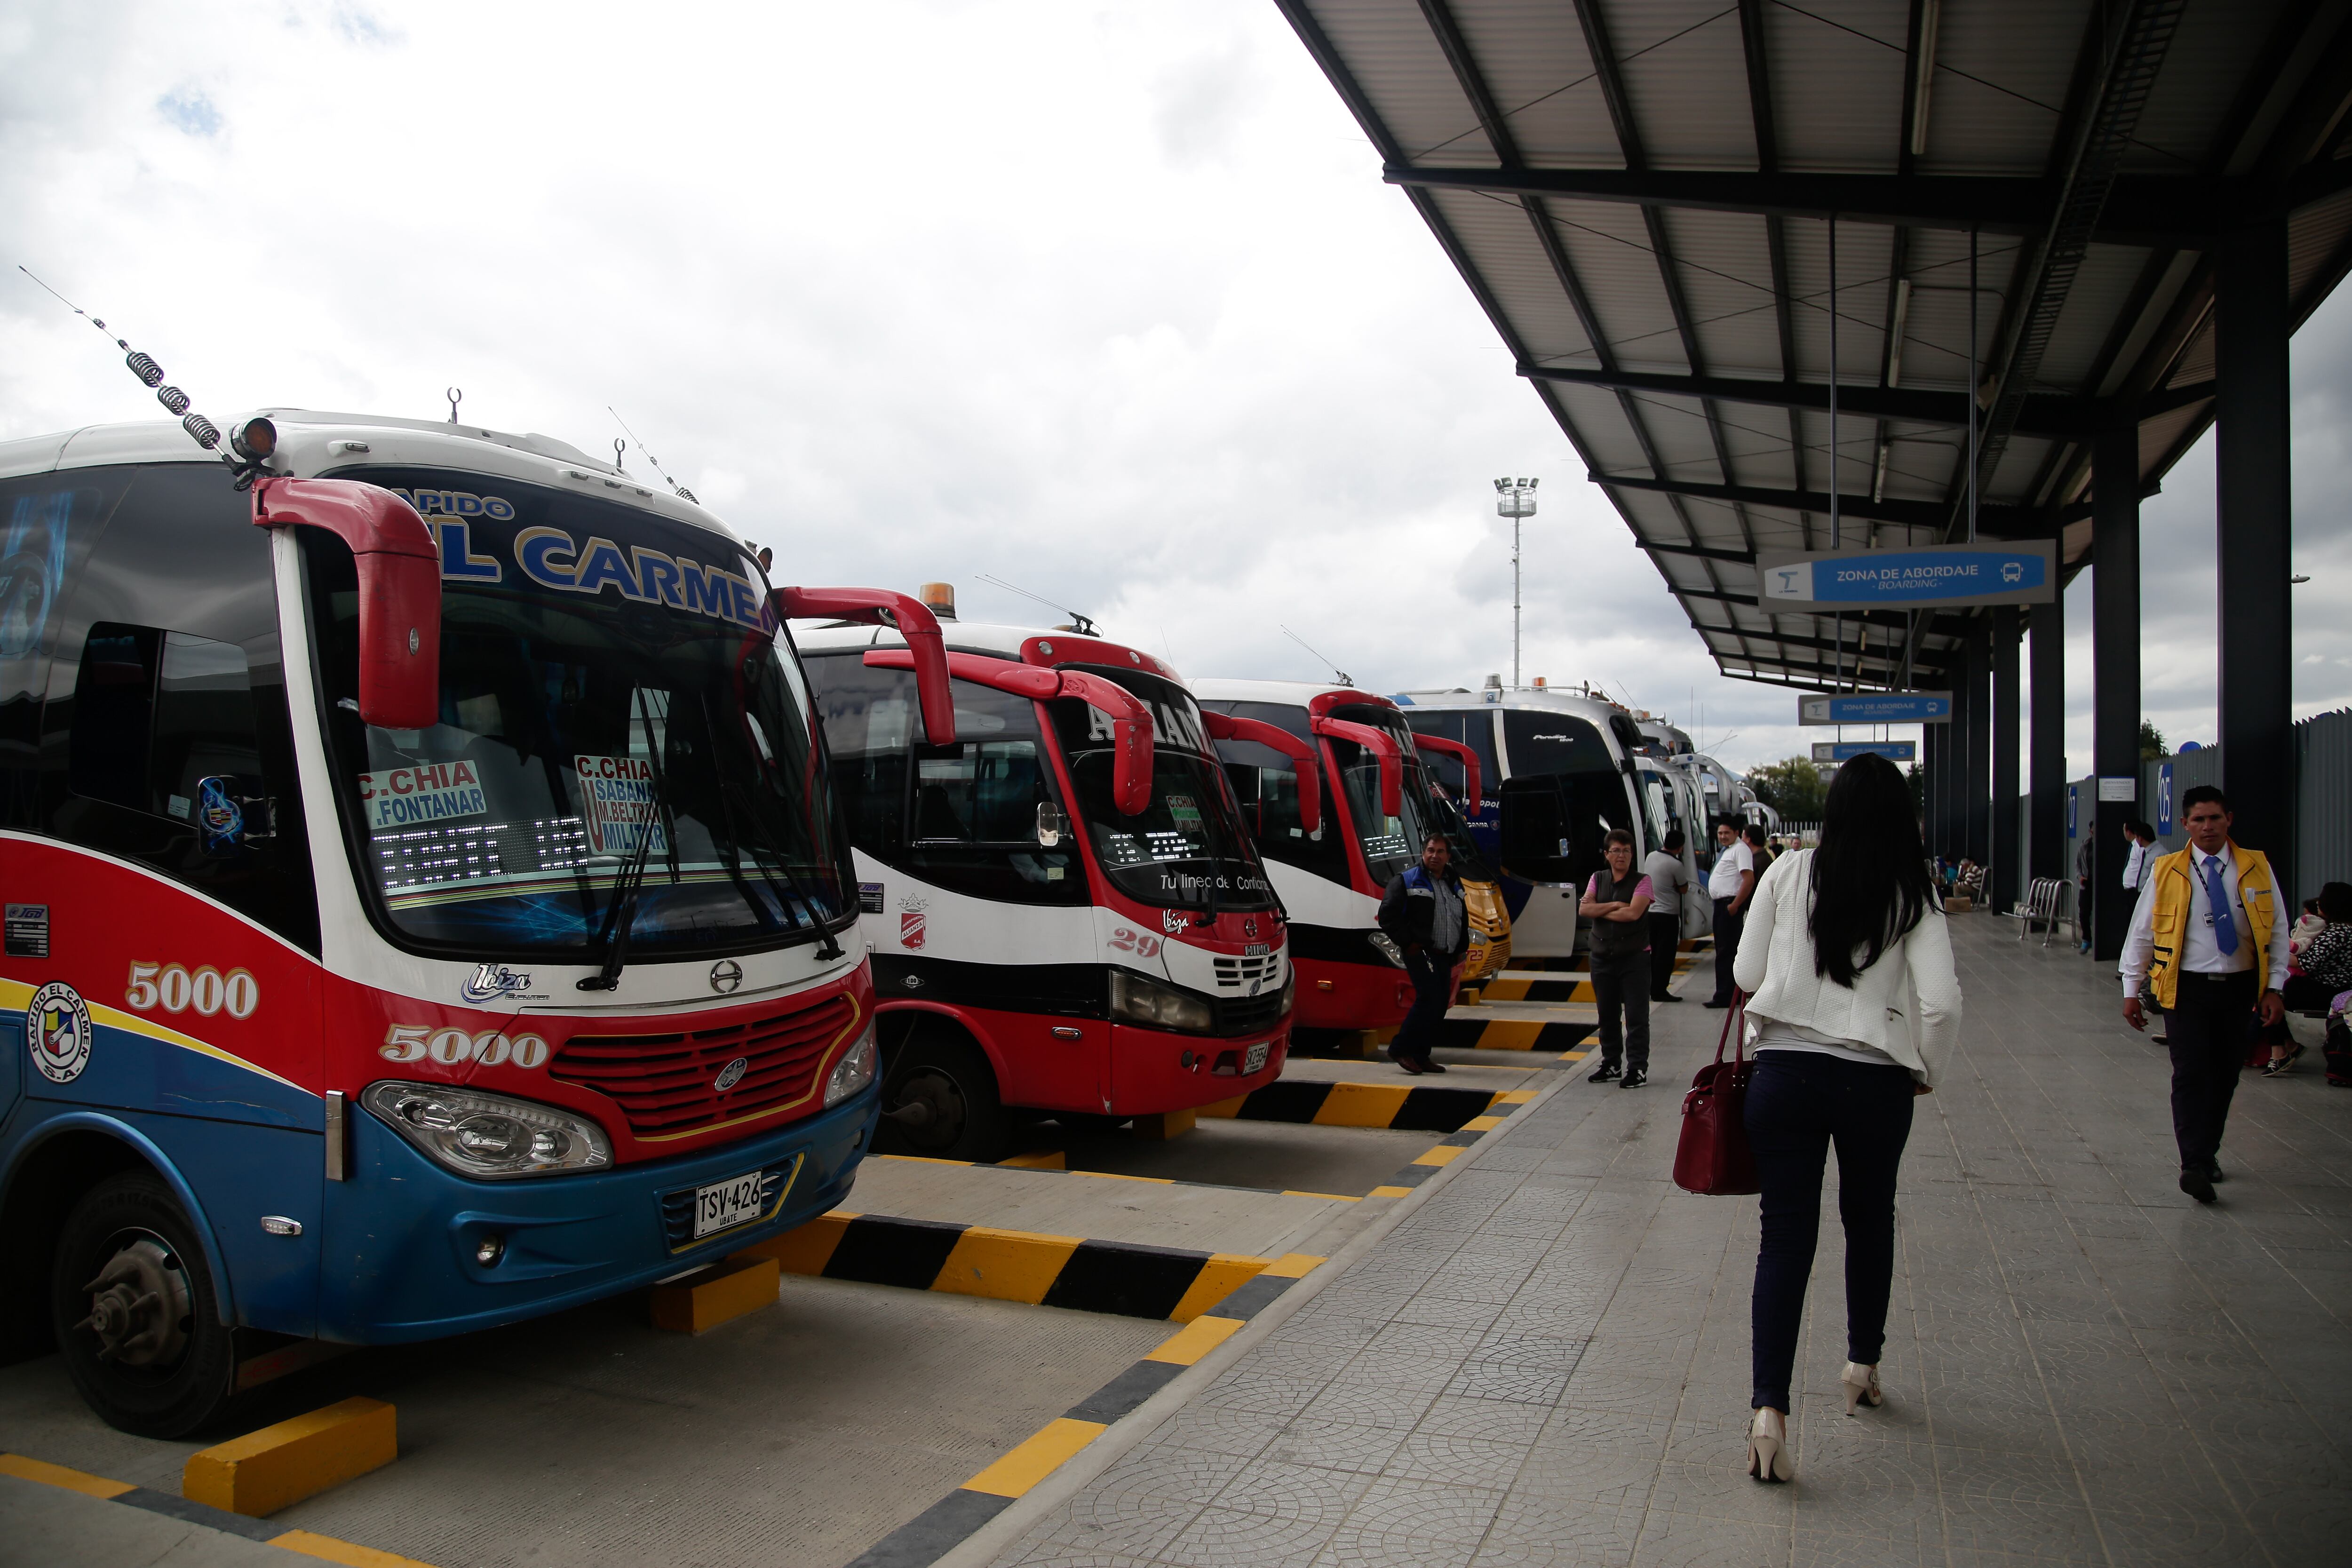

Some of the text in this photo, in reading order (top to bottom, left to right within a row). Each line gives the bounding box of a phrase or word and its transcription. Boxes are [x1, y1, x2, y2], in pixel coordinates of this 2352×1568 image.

[420, 514, 502, 582] L
[1837, 565, 1979, 582] ZONA DE ABORDAJE
[358, 762, 477, 800] C.CHIA
[577, 756, 654, 780] C.CHIA
[1168, 796, 1197, 808] C.CHIA
[2160, 776, 2169, 823] 05
[1160, 875, 1176, 889] Tu
[18, 907, 45, 918] JGB
[1162, 908, 1189, 934] Ibiza
[903, 922, 922, 938] ALIANZA
[1107, 927, 1160, 958] 29
[1244, 943, 1270, 957] HINO
[472, 963, 532, 990] Ibiza
[125, 960, 260, 1020] 5000
[30, 985, 90, 1059] RAPIDO EL CARMEN
[378, 1023, 550, 1068] 5000
[720, 1213, 737, 1226] UBATE
